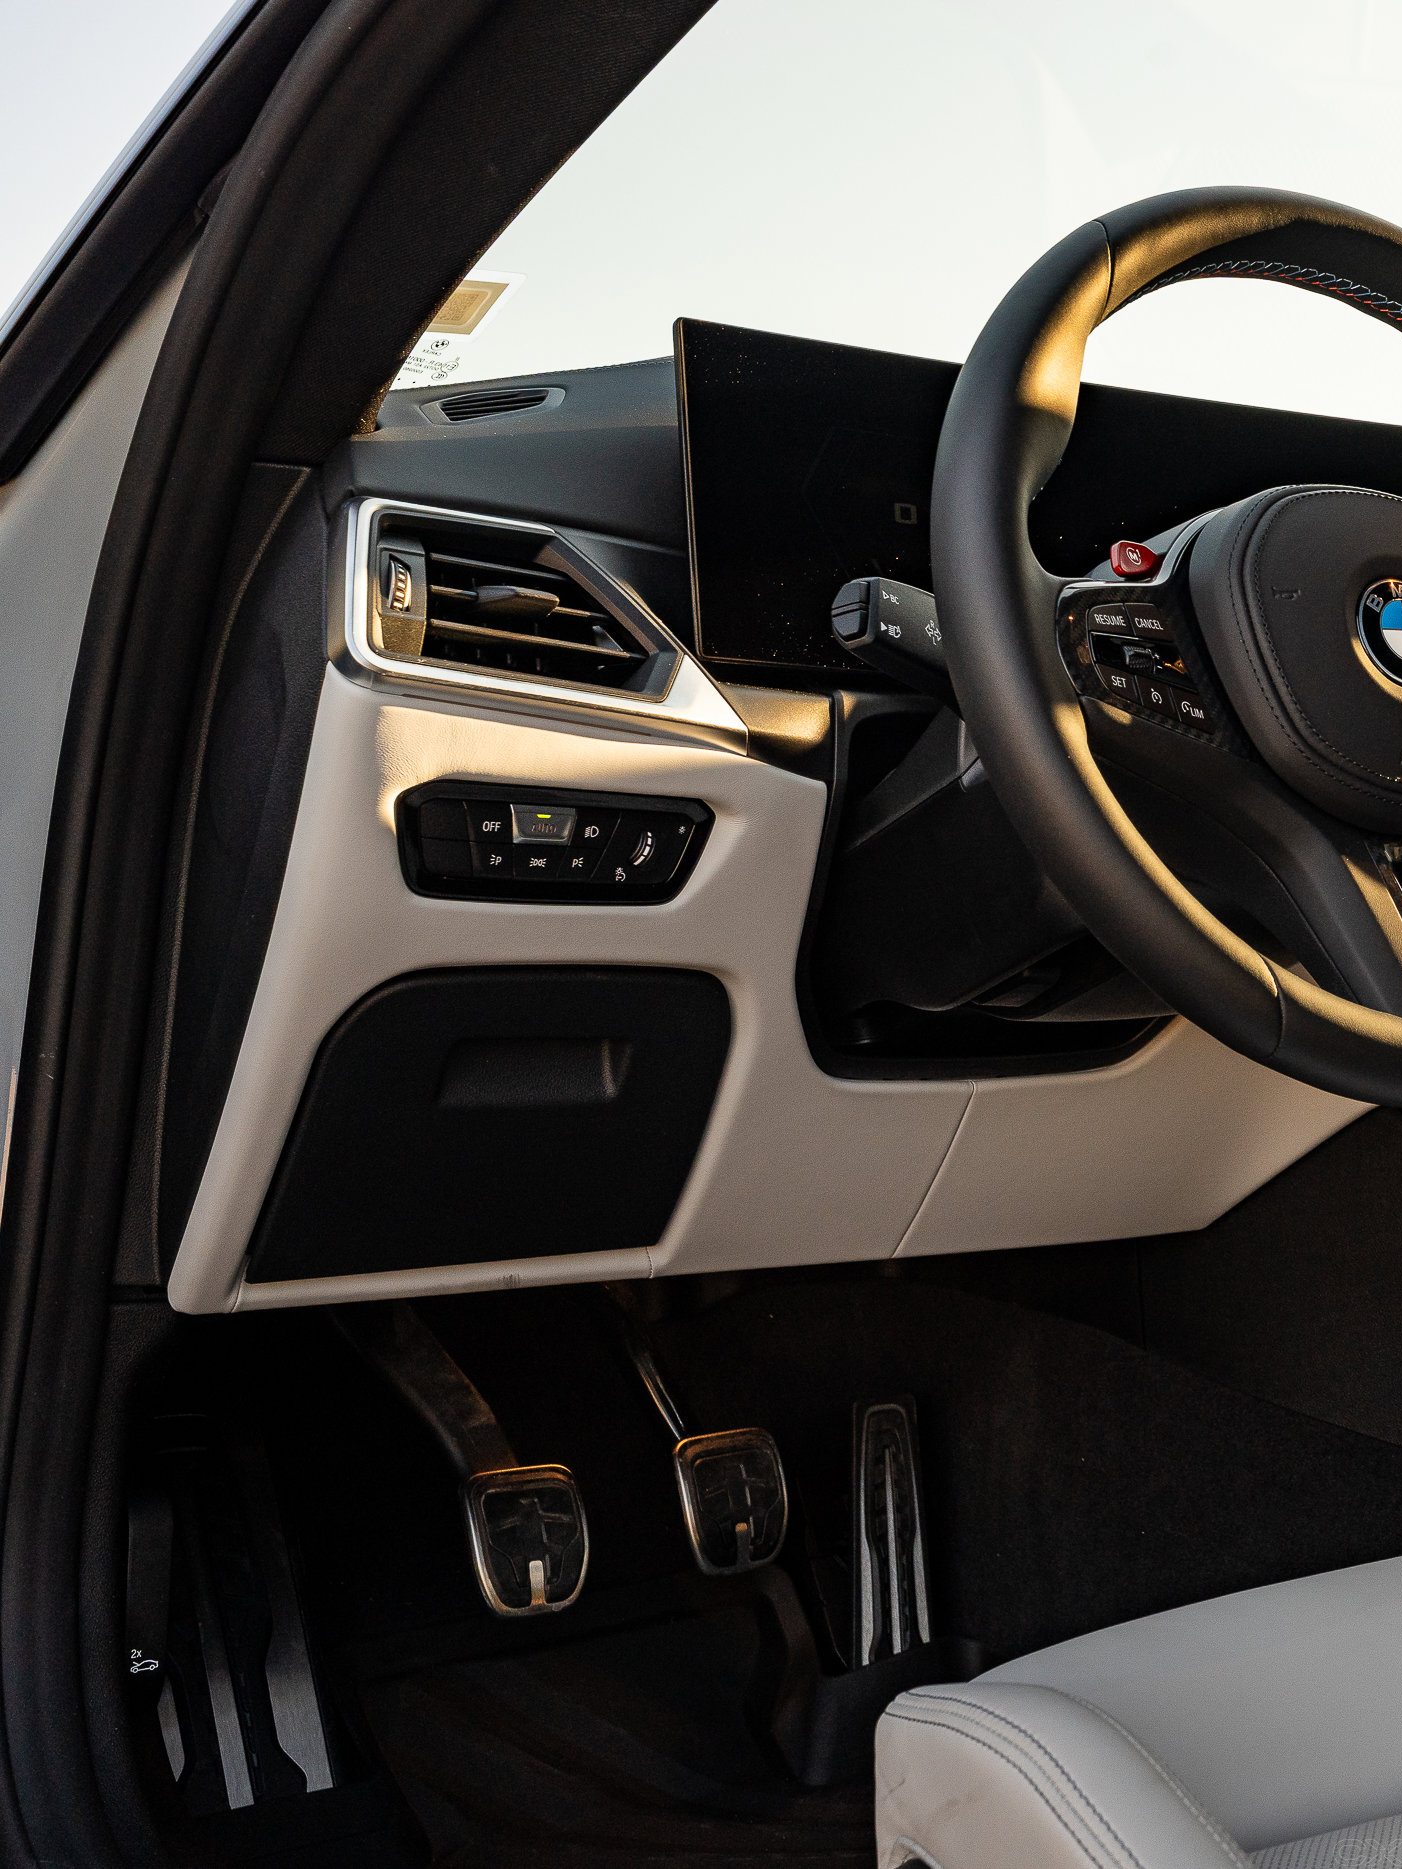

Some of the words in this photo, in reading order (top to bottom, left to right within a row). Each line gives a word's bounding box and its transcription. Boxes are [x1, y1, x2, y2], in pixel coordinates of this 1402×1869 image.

[1094, 613, 1127, 627] RESUME
[1135, 617, 1164, 631] CANCEL
[1111, 675, 1127, 688] SET
[1189, 706, 1205, 720] LIM
[482, 821, 502, 832] OFF
[131, 1649, 142, 1659] 2x
